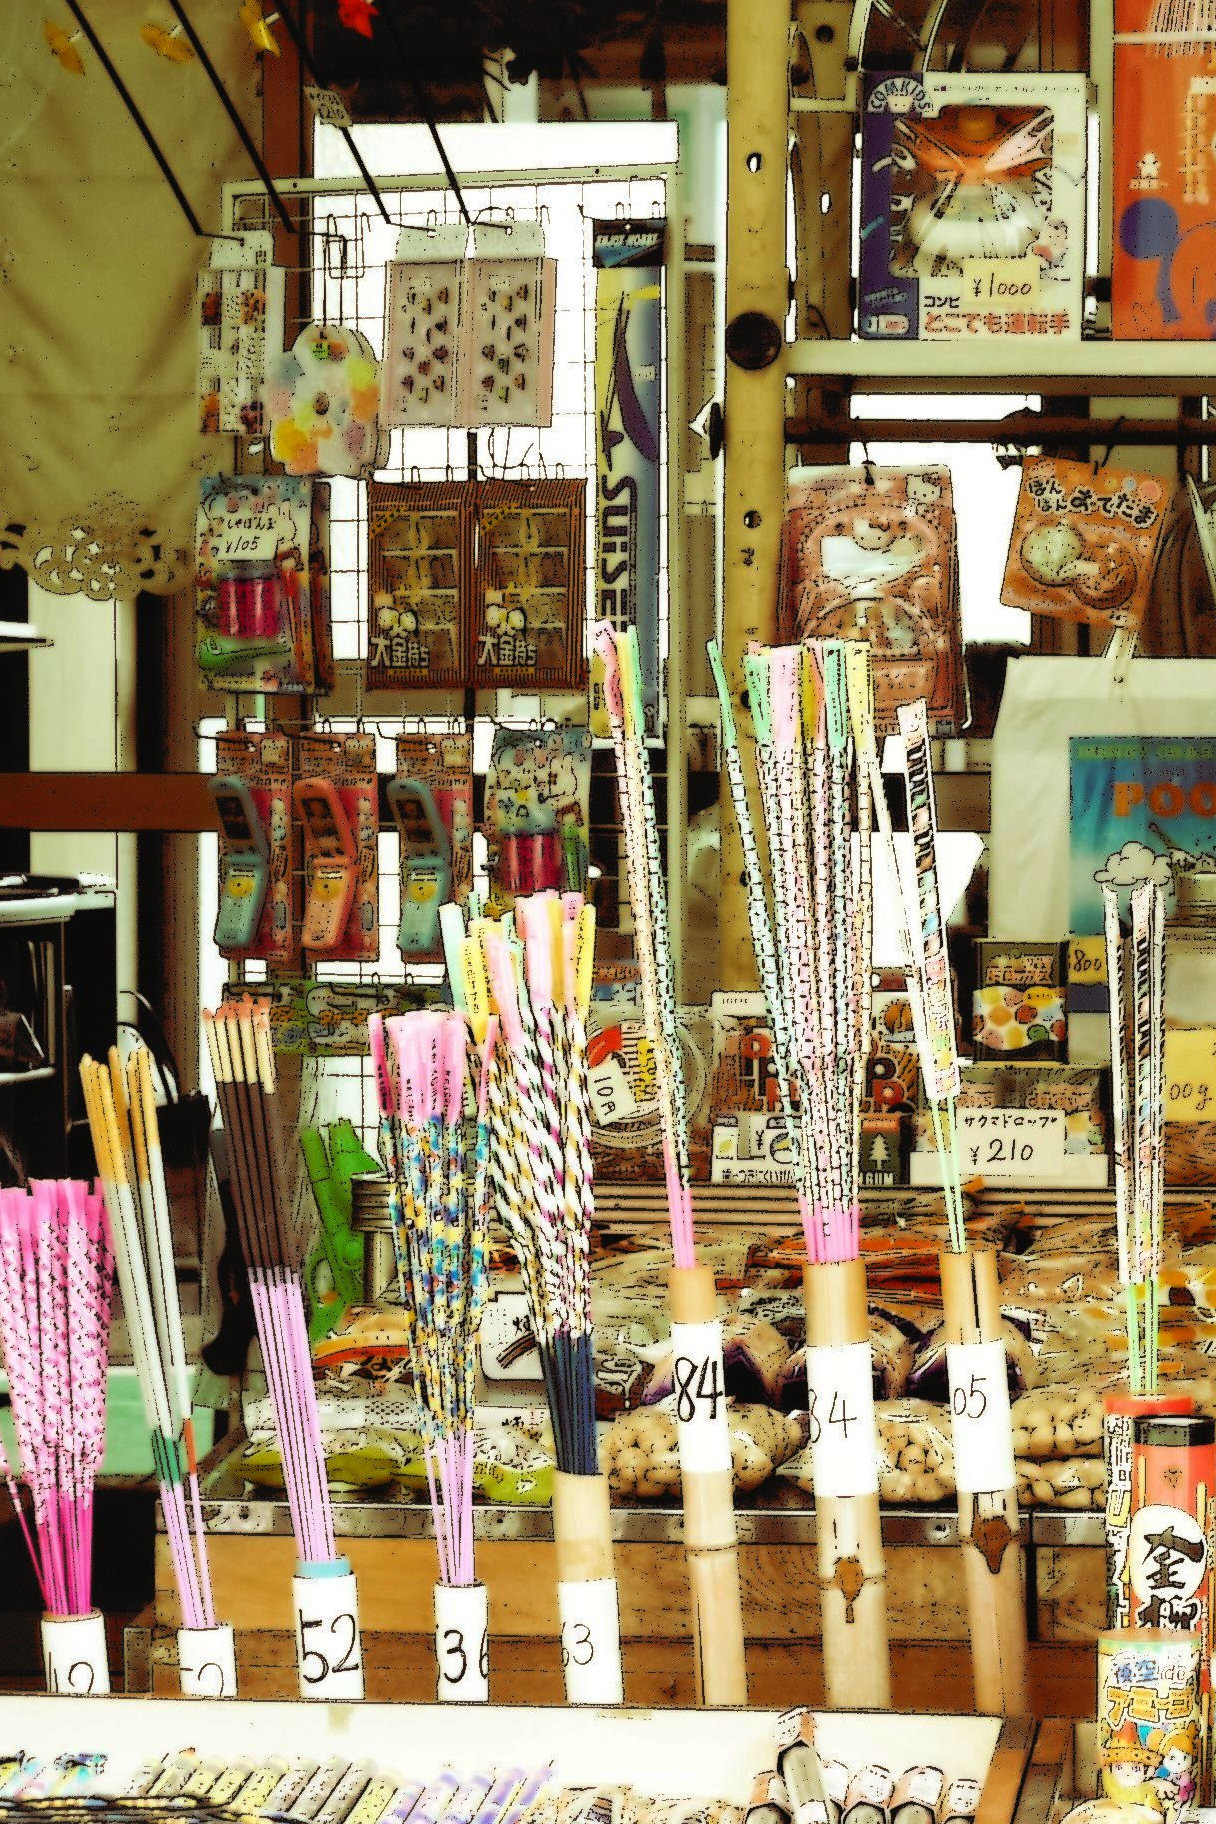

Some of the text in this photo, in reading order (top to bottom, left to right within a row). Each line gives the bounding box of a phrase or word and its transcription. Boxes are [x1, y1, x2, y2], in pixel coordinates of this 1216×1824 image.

[867, 78, 935, 112] COMKIDS
[973, 273, 1032, 297] ¥1000
[970, 1139, 1033, 1165] ¥210
[674, 1355, 724, 1422] 84
[299, 1609, 360, 1684] 52
